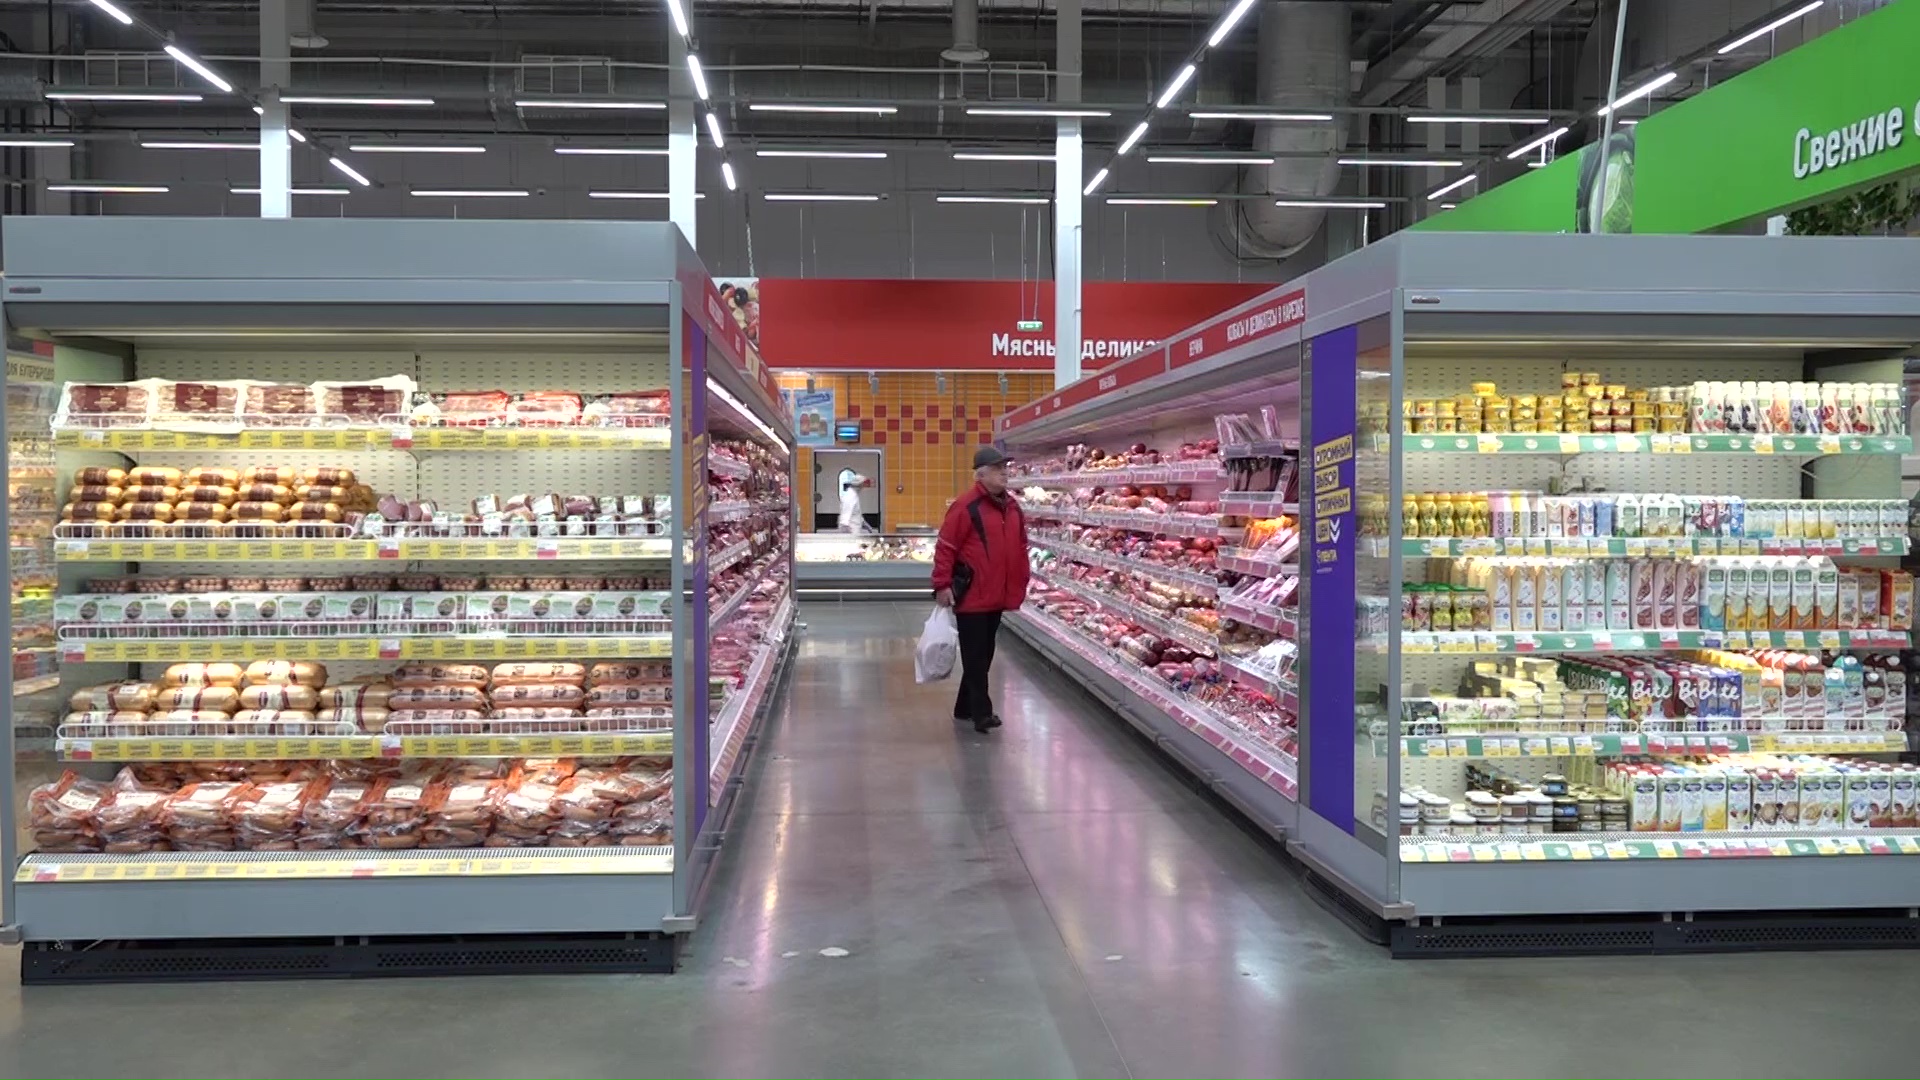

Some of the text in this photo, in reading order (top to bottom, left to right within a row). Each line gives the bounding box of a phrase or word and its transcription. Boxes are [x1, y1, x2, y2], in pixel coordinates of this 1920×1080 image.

[1793, 107, 1902, 178] Свежие
[992, 333, 1162, 360] Мясны делик
[1316, 438, 1351, 464] ОГРОМНЫЙ
[1316, 470, 1338, 490] ВЫБОР
[1631, 679, 1672, 700] Bite
